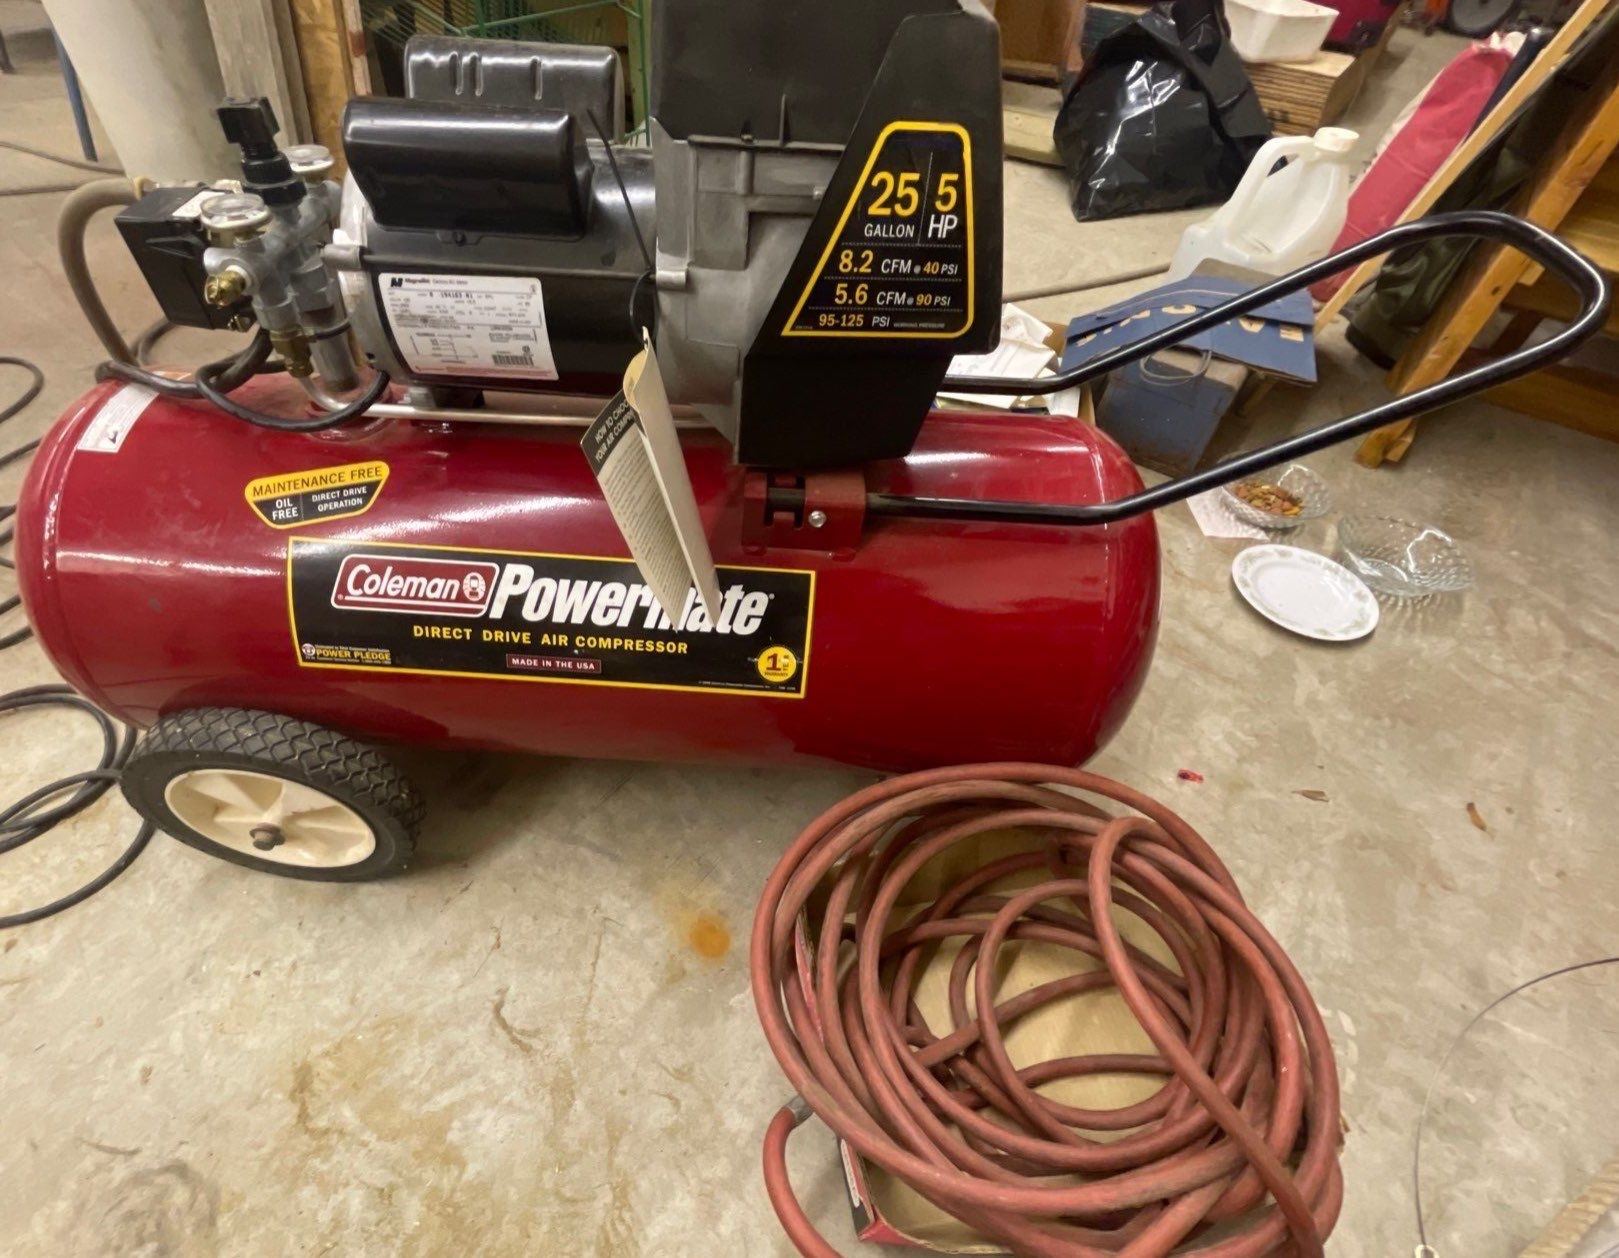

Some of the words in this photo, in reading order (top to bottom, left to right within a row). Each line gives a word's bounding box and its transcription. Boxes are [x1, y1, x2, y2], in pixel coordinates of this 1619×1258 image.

[868, 172, 920, 217] 25
[934, 173, 959, 212] 5
[864, 223, 915, 239] GALLON
[928, 213, 958, 239] HP
[839, 249, 875, 274] 8.2
[881, 258, 912, 275] CFM
[923, 261, 940, 275] 40
[940, 263, 958, 275] PSI
[834, 283, 869, 305] 5.6
[876, 291, 907, 306] CFM
[916, 294, 933, 306] 90
[933, 296, 951, 307] PSI
[819, 313, 864, 327] 95-125
[872, 315, 890, 327] PSI
[253, 472, 346, 497] MAINTENANCE
[350, 467, 382, 480] FREE
[275, 498, 293, 509] OIL
[311, 490, 342, 502] DIRECT
[343, 486, 367, 498] DRIVE
[271, 507, 299, 521] FREE
[317, 497, 363, 513] OPERATION
[346, 563, 460, 601] Coleman
[412, 625, 472, 641] DIRECT
[482, 629, 532, 645] DRIVE
[541, 633, 568, 647] AIR
[575, 636, 689, 655] COMPRESSOR
[316, 648, 350, 658] POWER
[353, 651, 391, 661] PLEDGE
[512, 657, 539, 668] MADE
[541, 659, 551, 667] IN
[555, 660, 574, 669] THE
[576, 661, 595, 670] USA
[765, 653, 782, 672] 1
